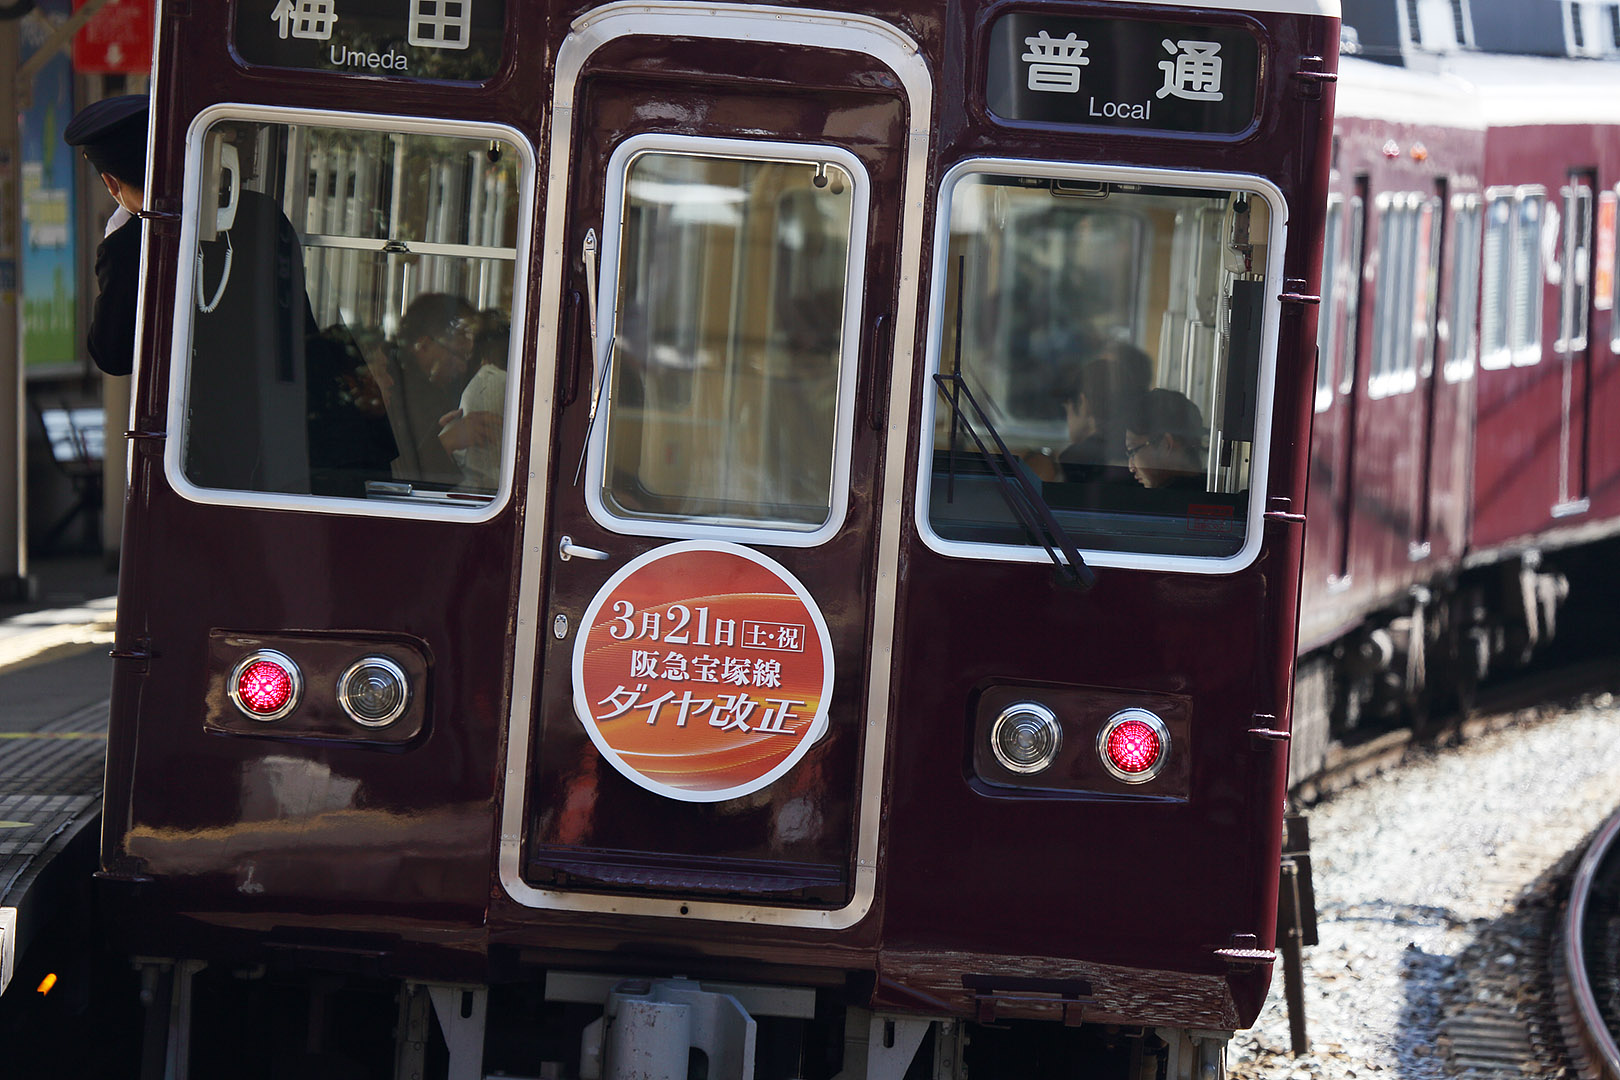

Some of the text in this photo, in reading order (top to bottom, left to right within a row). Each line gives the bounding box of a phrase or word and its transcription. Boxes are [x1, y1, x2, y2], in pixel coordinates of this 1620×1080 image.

[329, 45, 409, 71] Umeda
[1021, 30, 1224, 101] 普通
[1089, 96, 1151, 120] Local
[609, 600, 736, 647] 3月21日
[630, 650, 782, 688] 阪急宝塚線
[596, 683, 806, 735] ダイヤ改正
